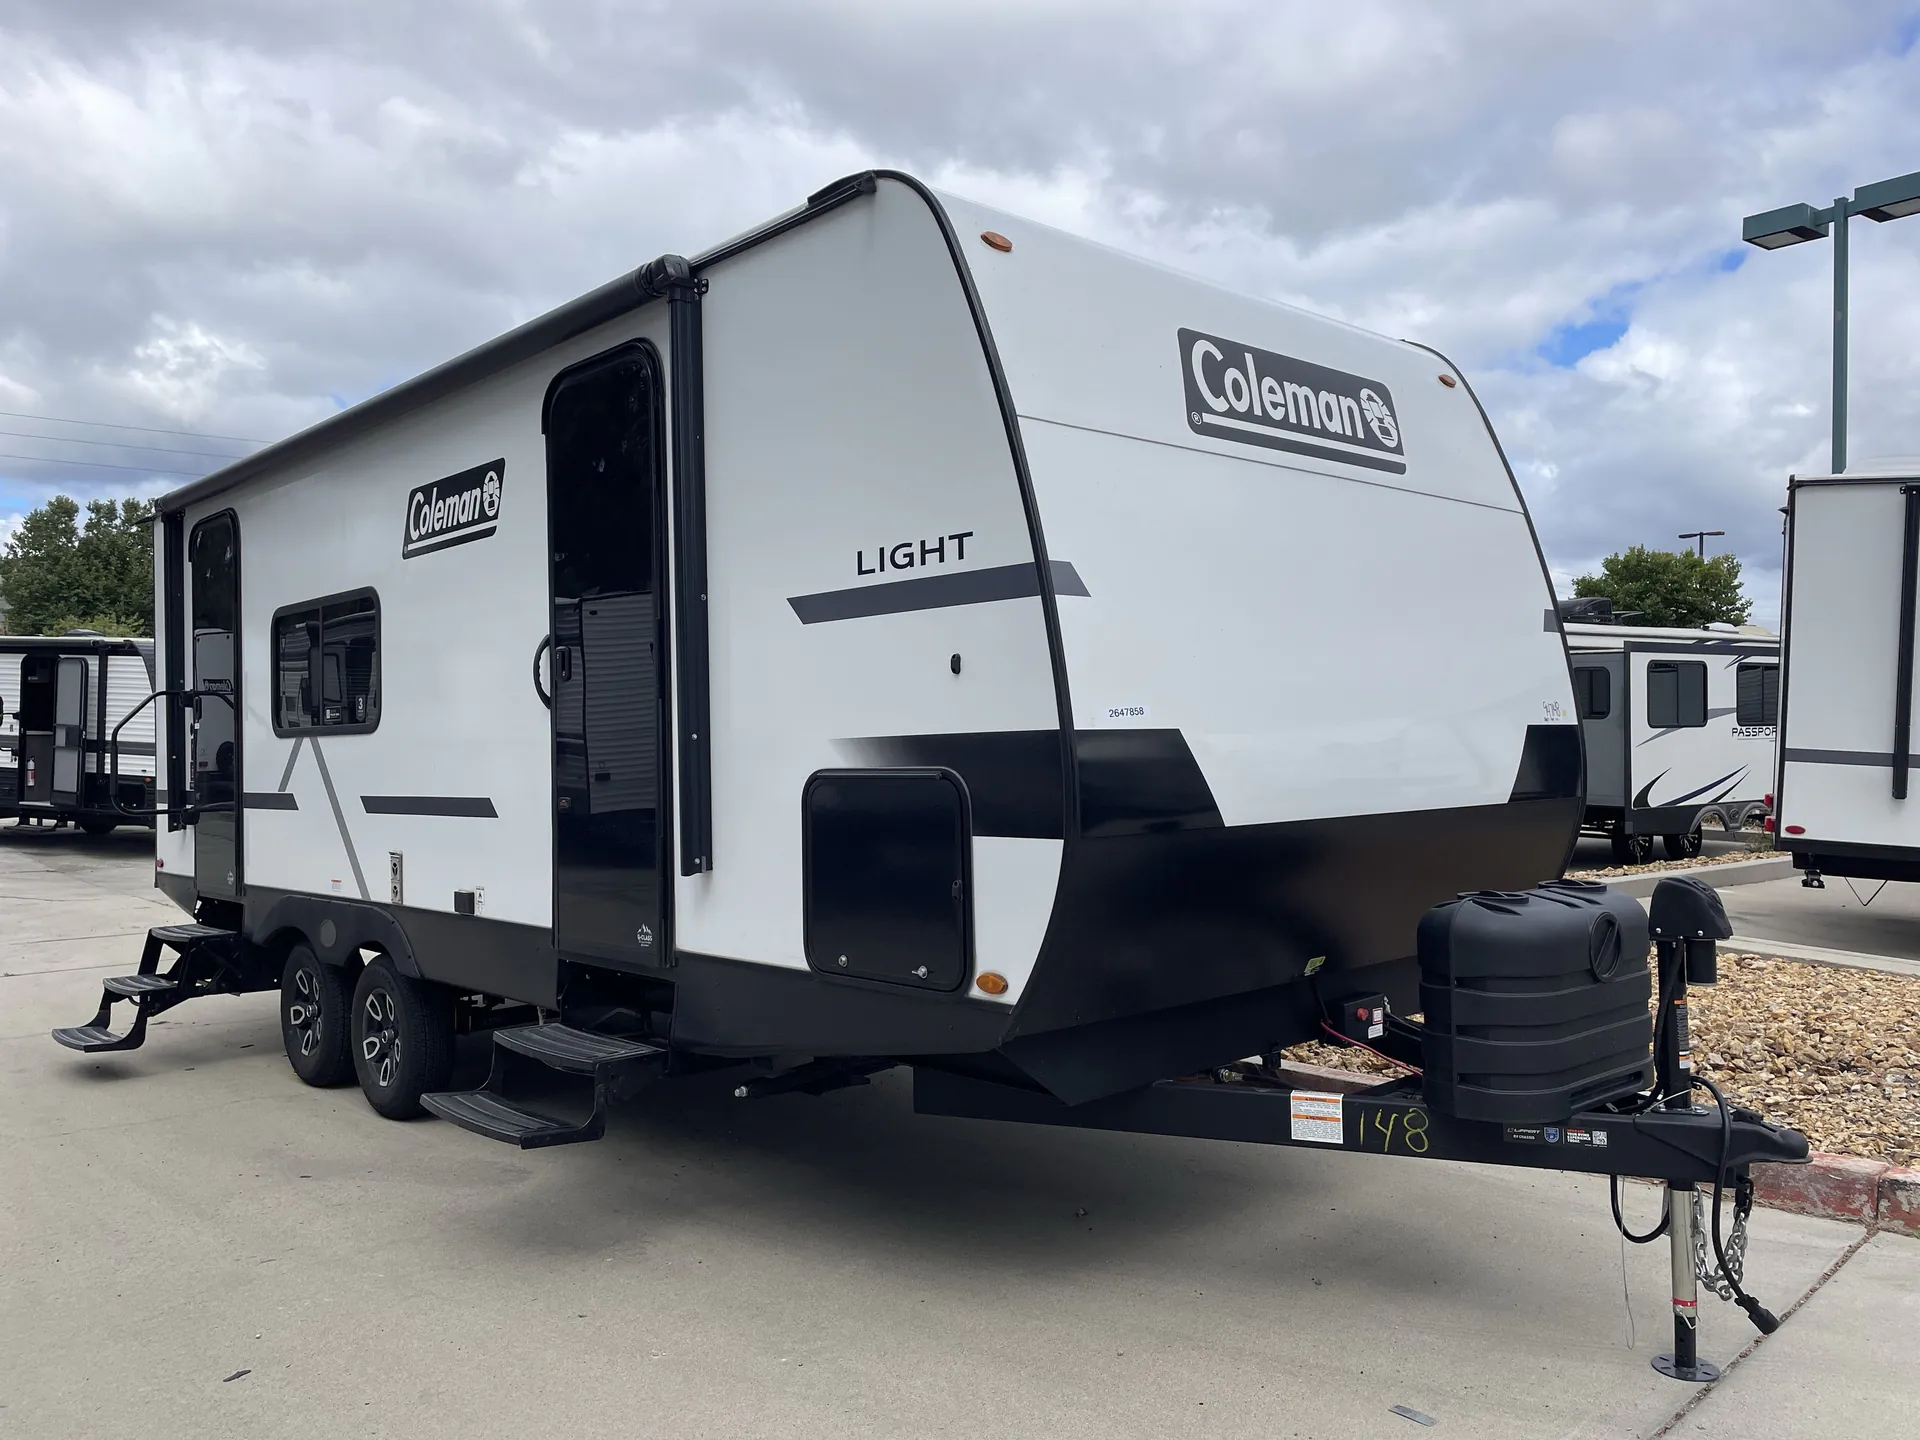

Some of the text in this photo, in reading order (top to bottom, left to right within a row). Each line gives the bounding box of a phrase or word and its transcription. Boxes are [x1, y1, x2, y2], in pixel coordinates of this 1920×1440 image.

[1192, 340, 1364, 439] Coleman
[409, 487, 481, 540] Coleman
[857, 531, 973, 575] LIGHT
[358, 697, 363, 710] 3
[1108, 706, 1145, 718] 2647858
[1360, 1107, 1429, 1153] 148
